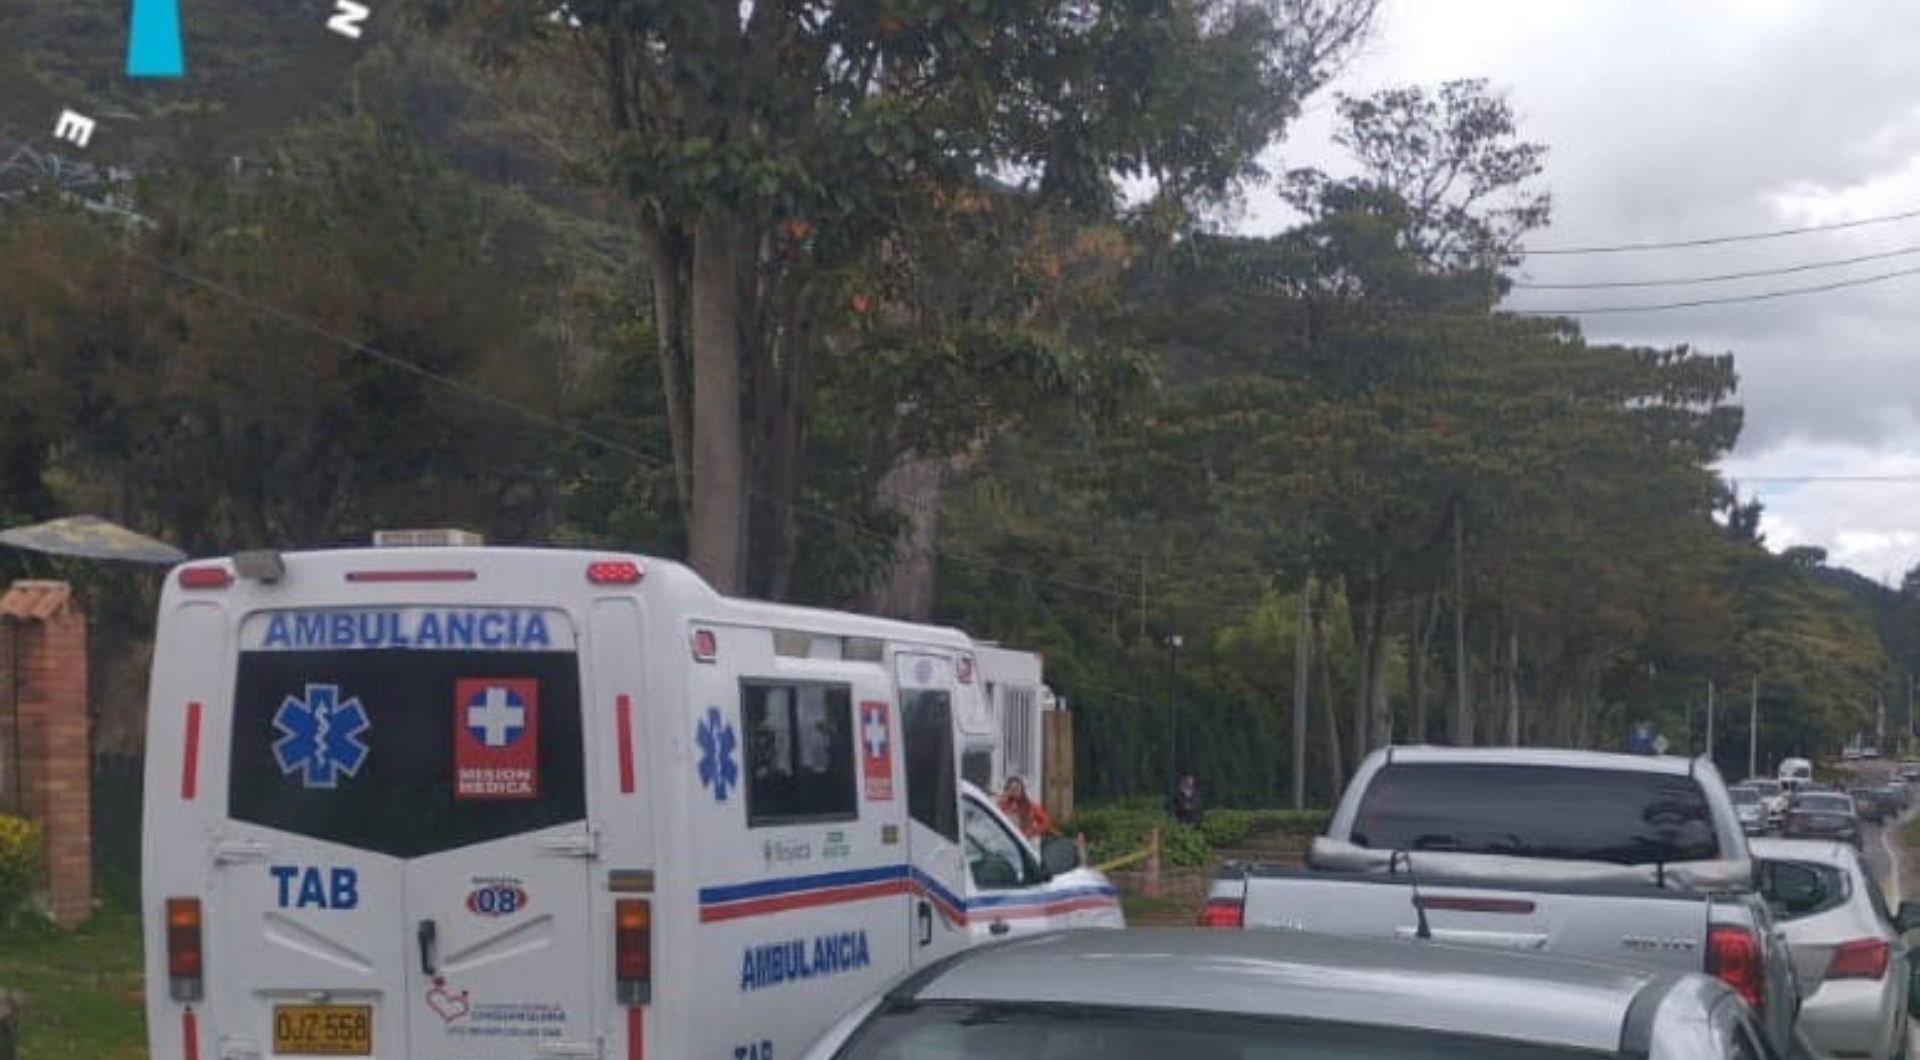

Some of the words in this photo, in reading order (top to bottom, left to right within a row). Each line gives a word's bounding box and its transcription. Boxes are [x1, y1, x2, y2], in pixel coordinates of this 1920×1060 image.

[264, 612, 549, 646] AMBULANCIA
[459, 782, 532, 794] MEDICA
[270, 866, 359, 910] TAB
[477, 889, 516, 912] 08
[741, 929, 871, 991] AMBULANCIA
